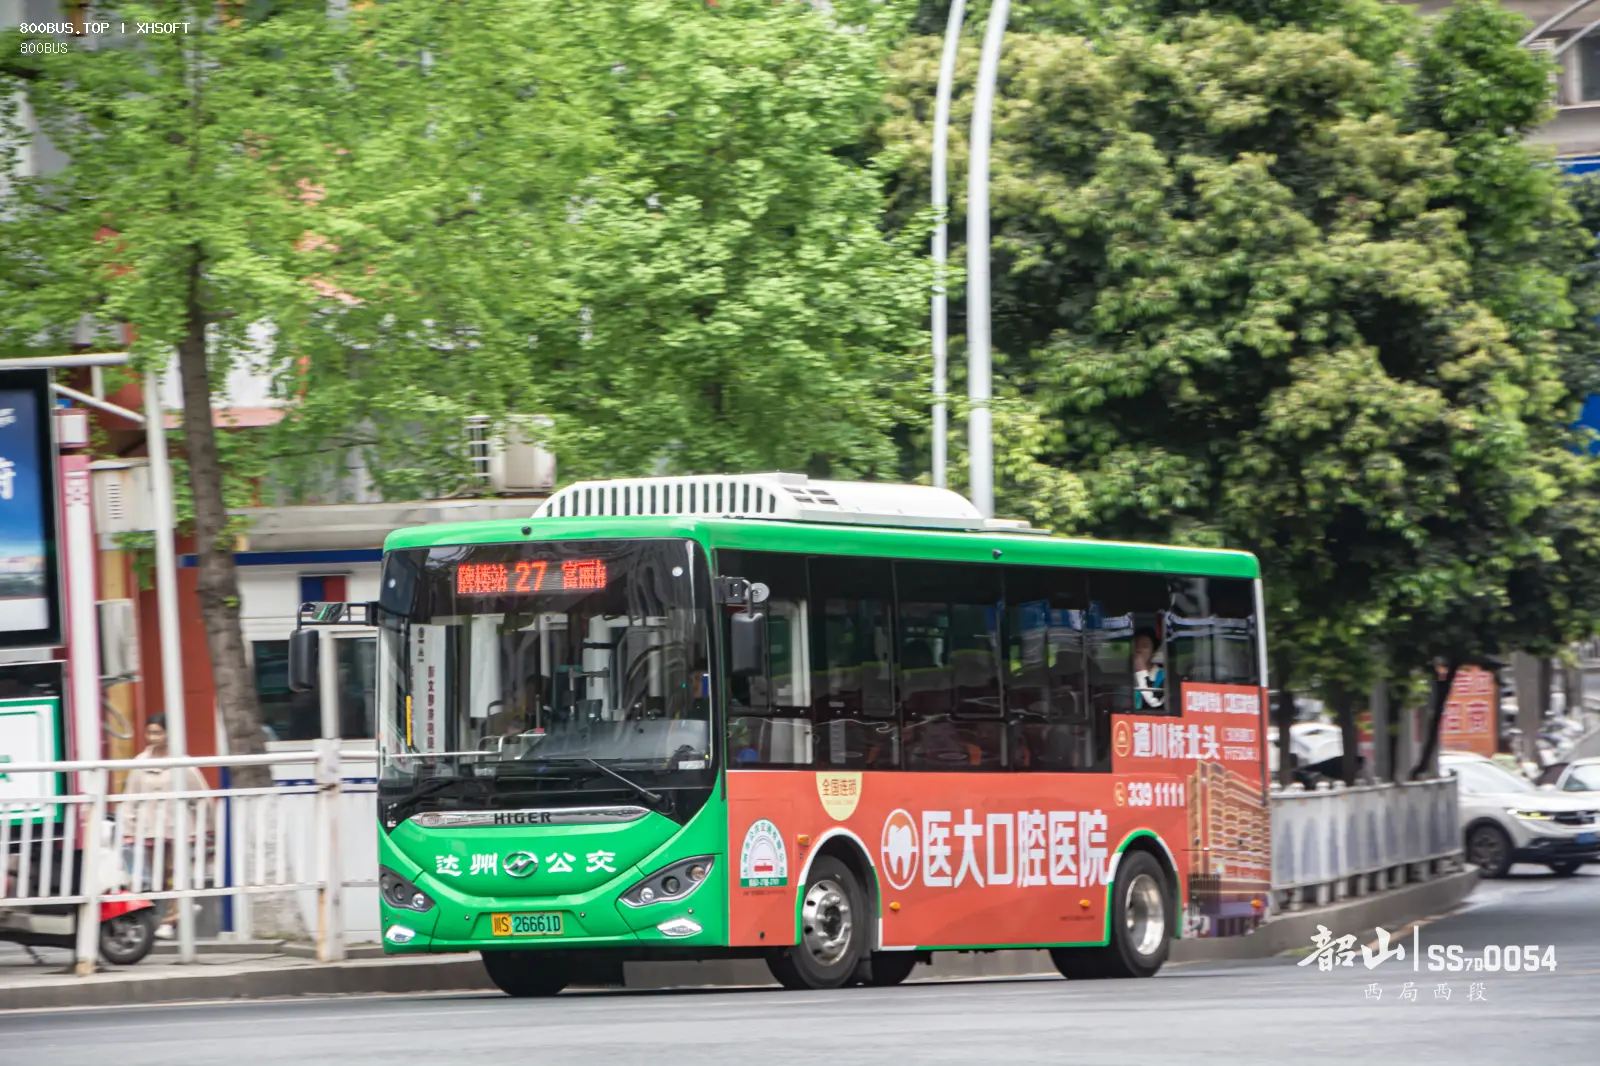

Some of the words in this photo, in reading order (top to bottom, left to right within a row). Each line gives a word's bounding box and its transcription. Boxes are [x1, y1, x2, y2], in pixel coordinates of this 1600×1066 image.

[515, 560, 547, 592] 27
[494, 811, 552, 825] HIGER
[922, 809, 1109, 888] 医大口腔医院
[435, 853, 498, 877] 达州
[545, 850, 617, 874] 公交
